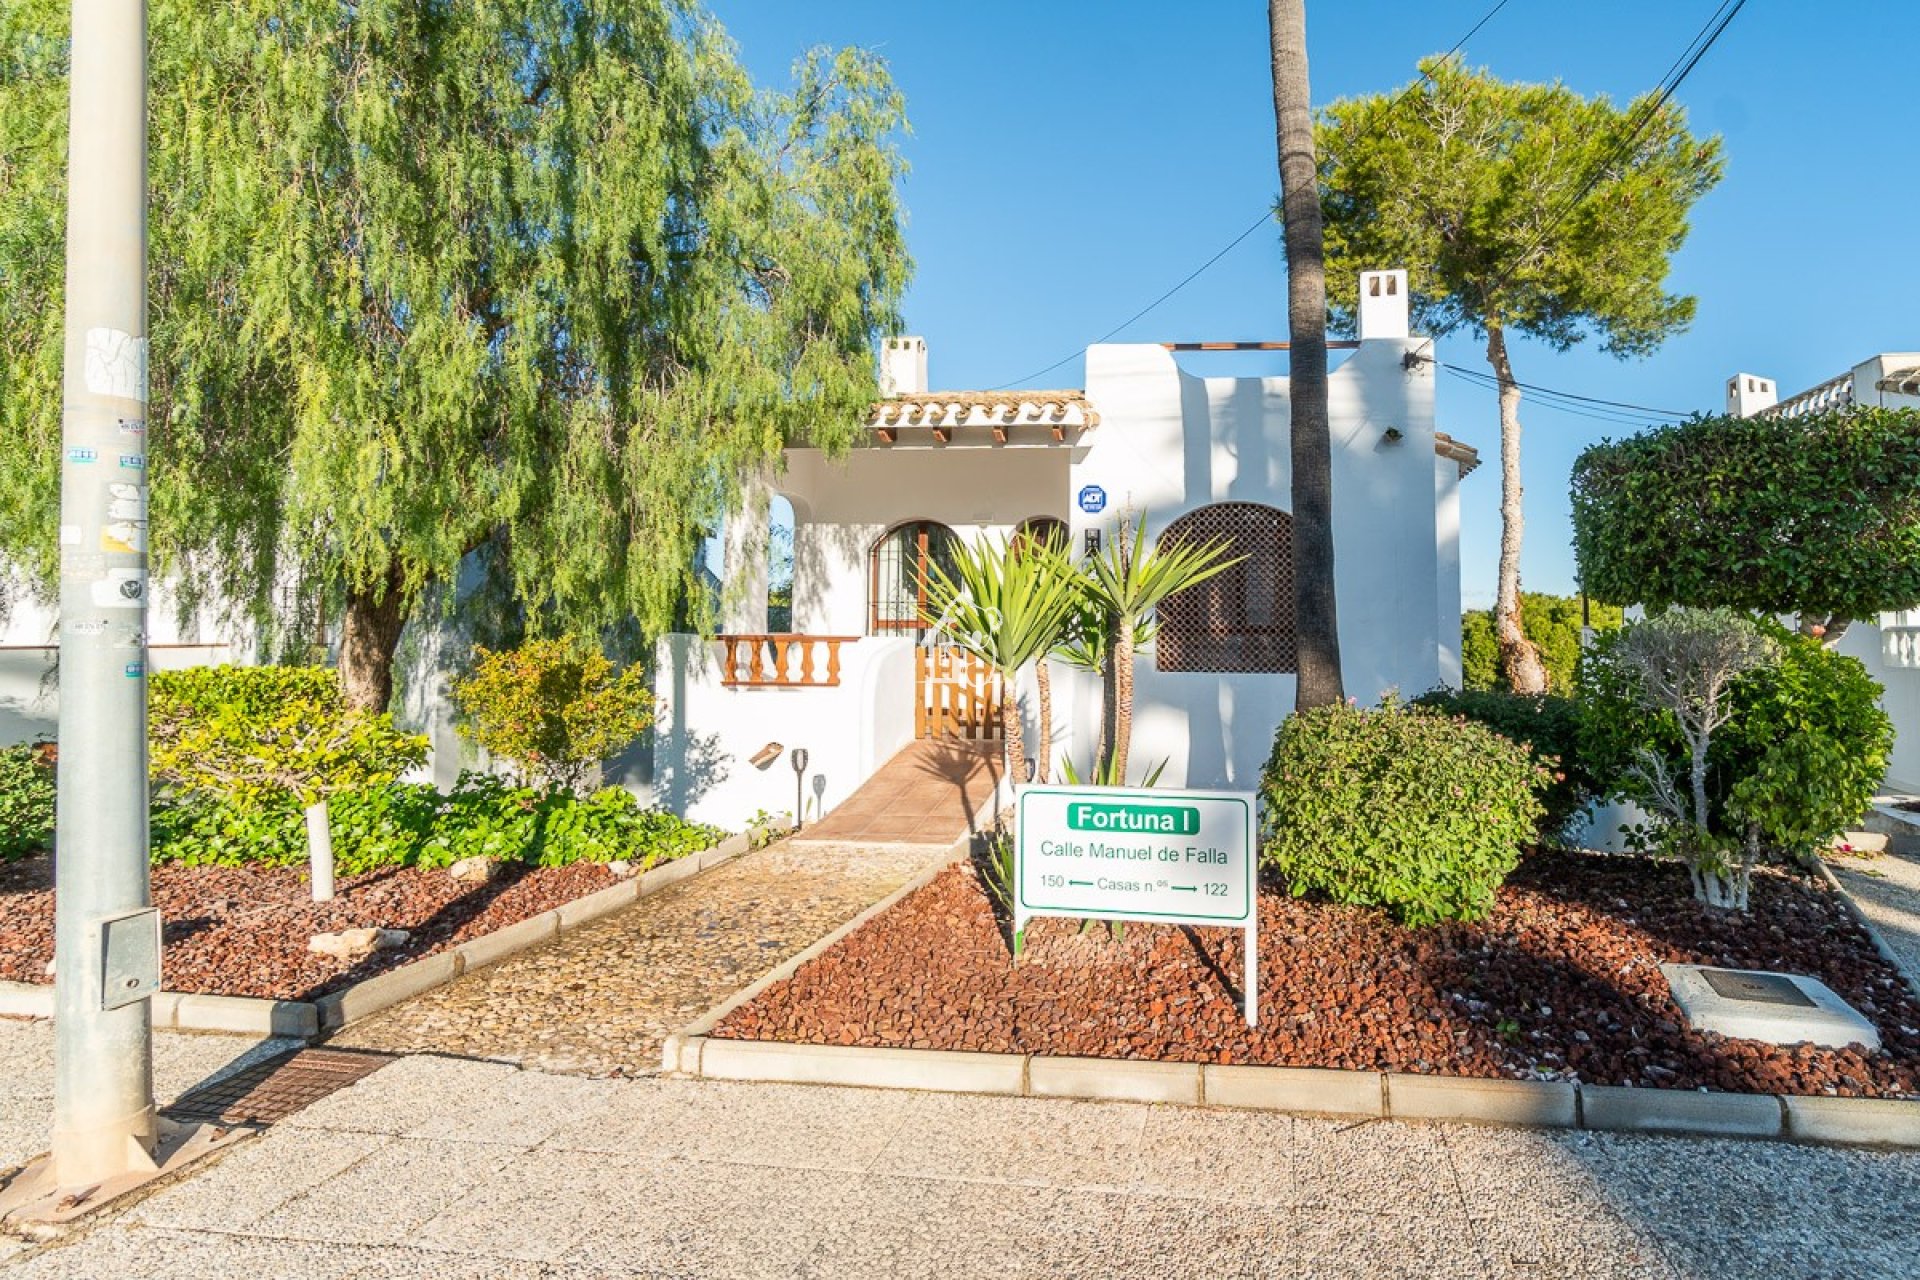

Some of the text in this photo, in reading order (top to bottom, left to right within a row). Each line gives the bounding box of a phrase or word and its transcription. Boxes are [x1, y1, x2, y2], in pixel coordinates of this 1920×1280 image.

[1077, 806, 1189, 831] Fortuna I
[1040, 841, 1228, 865] Calle Manuel de Falla
[1040, 875, 1064, 888] 150
[1098, 878, 1140, 892] Casas
[1203, 883, 1228, 897] 122
